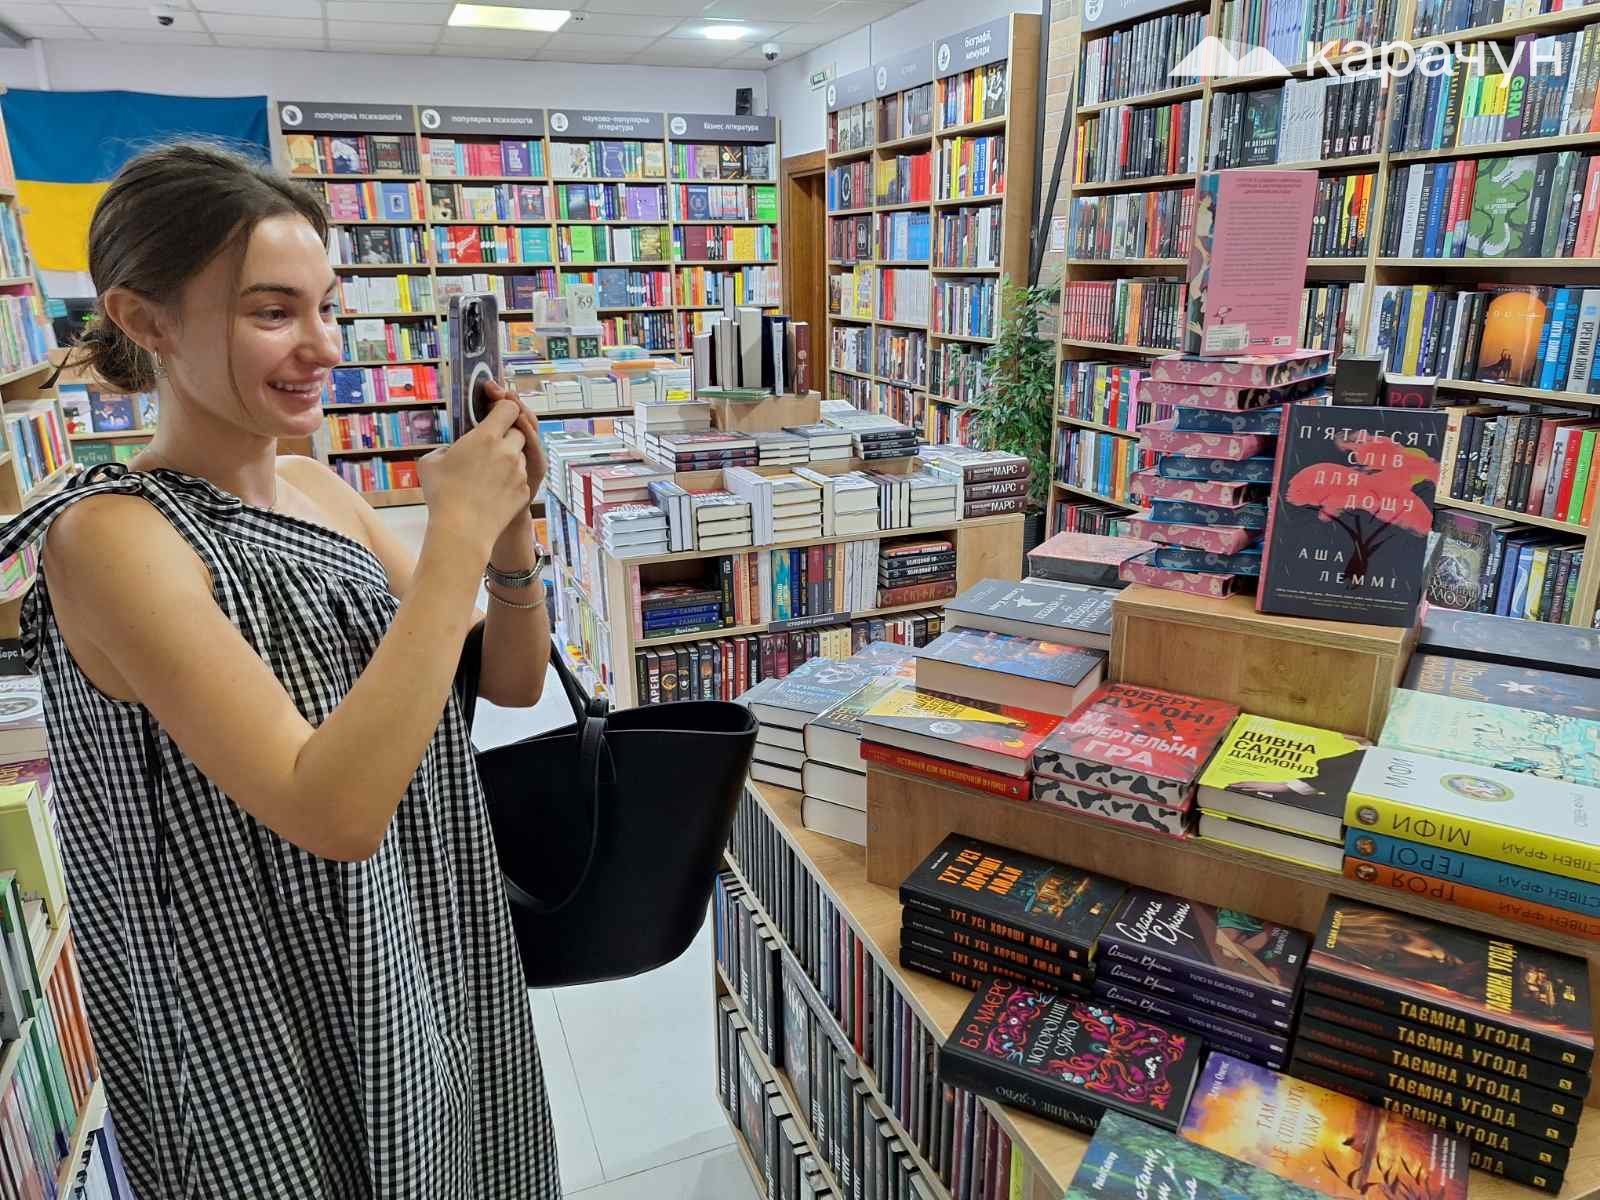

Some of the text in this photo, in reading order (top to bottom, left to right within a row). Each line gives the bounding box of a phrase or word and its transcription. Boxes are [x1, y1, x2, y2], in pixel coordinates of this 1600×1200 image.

[1507, 76, 1525, 118] GRM
[993, 464, 1018, 477] МАРС
[1347, 451, 1404, 468] СЛІВ
[992, 483, 1016, 494] МАРС
[1314, 470, 1360, 487] ДЛЯ
[991, 500, 1015, 511] МАРС
[1344, 494, 1415, 512] ДОЩУ
[1298, 547, 1344, 562] АША
[1319, 570, 1397, 589] ЛЕММІ
[1108, 685, 1204, 709] РОБЕРТ
[1070, 721, 1198, 759] СМЕРТЕЛЬНА
[1083, 739, 1153, 767] ГРА
[1234, 740, 1302, 763] САЛЛІ
[1238, 730, 1316, 754] ДИВНА
[1227, 749, 1319, 774] ДАЙМОНД
[1391, 813, 1472, 848] МІФИ
[1501, 840, 1543, 861] ФРАЙ
[937, 865, 966, 885] ТУТ
[955, 849, 982, 866] УСІ
[961, 856, 1004, 892] ХОРОШІ
[1388, 846, 1600, 909] СТІВЕН ФРАЙ ГЕРОЇ
[1391, 873, 1457, 900] ТРОЯ
[950, 909, 1058, 952] ТУТ УСІ ХОРОШІ ЛЮДИ
[953, 932, 969, 946] ТУТ
[1486, 940, 1516, 1014] ТАЄМНА УГОДА
[1400, 1000, 1532, 1053] ТАЄМНА УГОДА
[1398, 1026, 1528, 1079] ТАЄМНА УГОДА
[1391, 1050, 1522, 1104] ТАЄМНА УГОДА
[1388, 1073, 1516, 1128] ТАЄМНА УГОДА
[1255, 1102, 1275, 1130] ТАМ
[1456, 1121, 1510, 1152] УГОДА
[1471, 1151, 1504, 1175] ОДА
